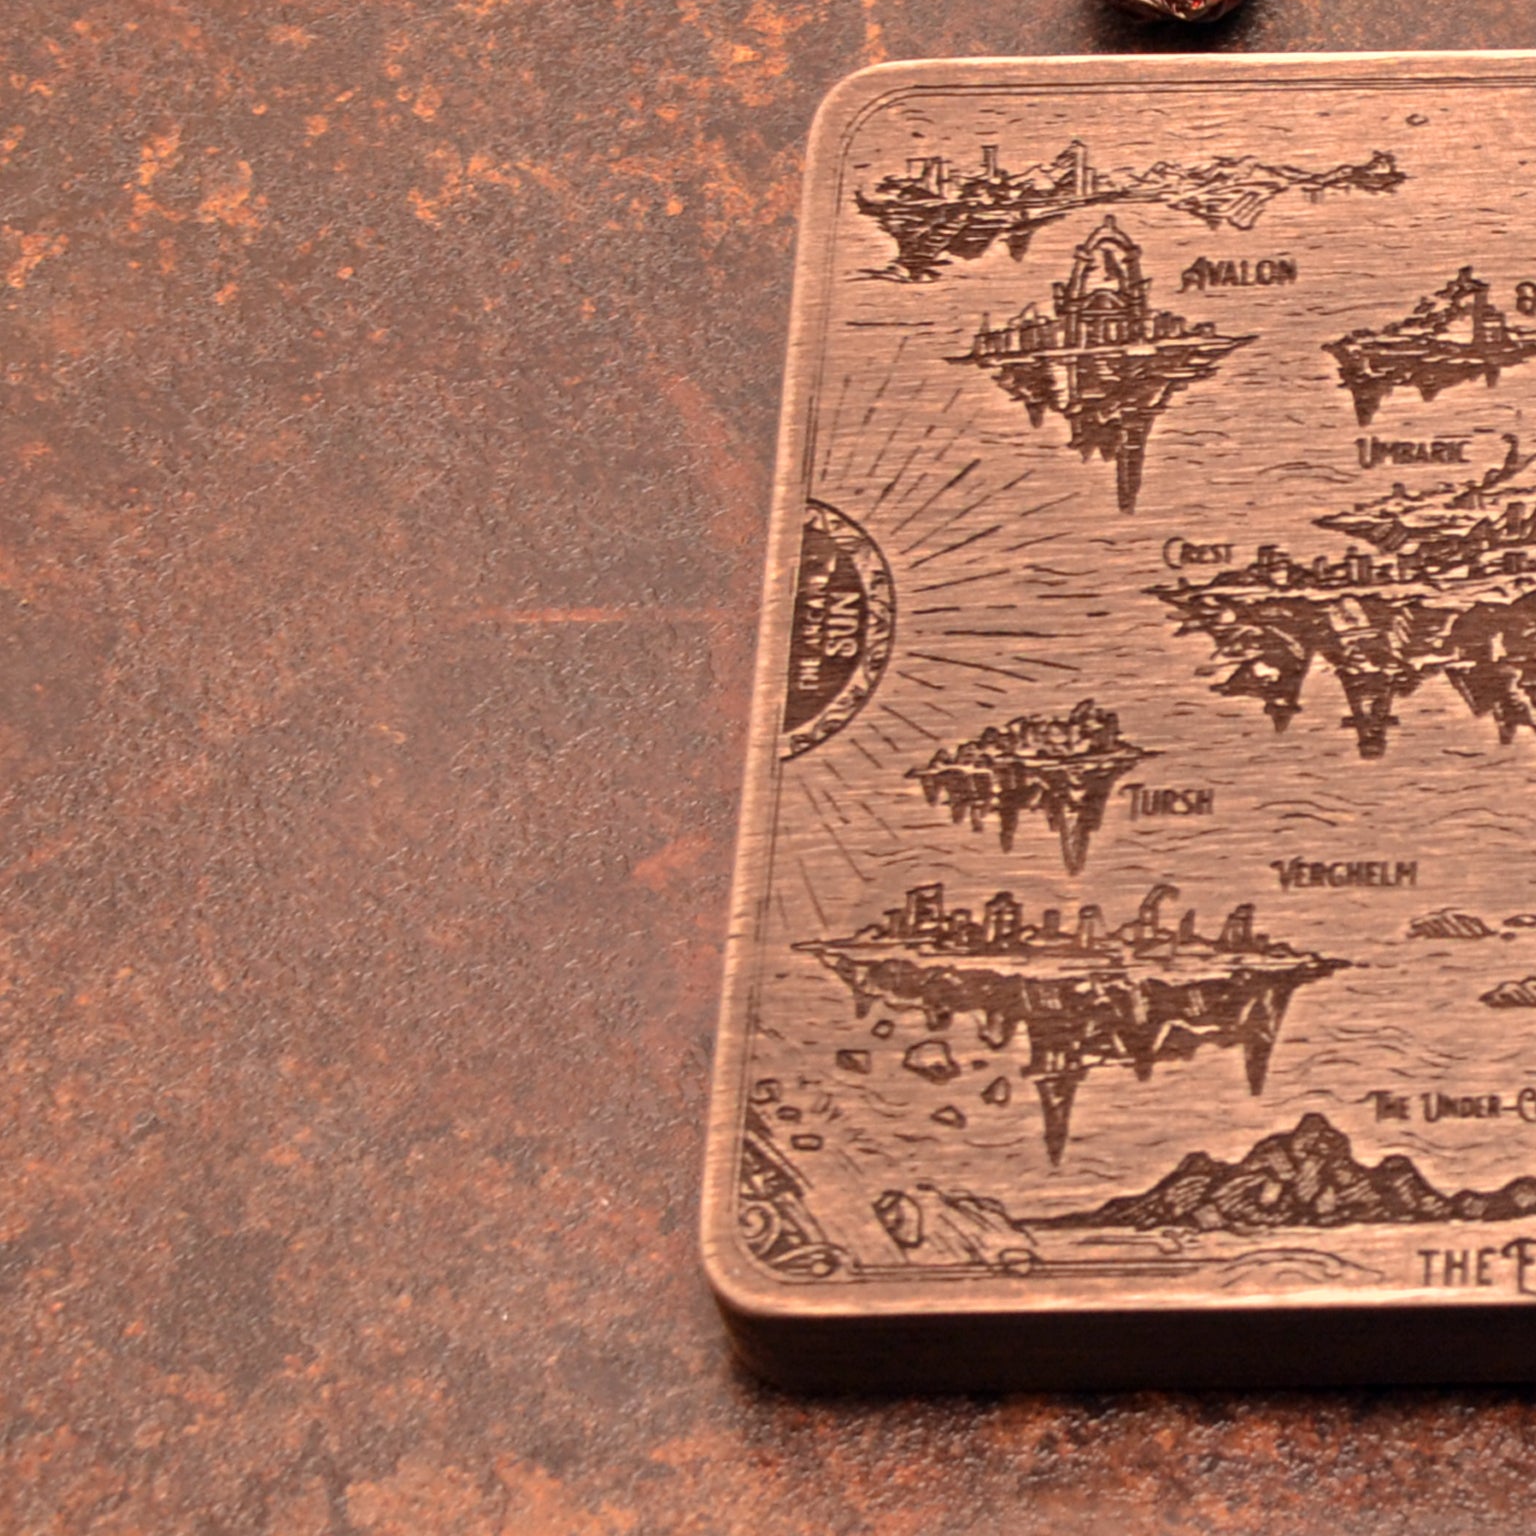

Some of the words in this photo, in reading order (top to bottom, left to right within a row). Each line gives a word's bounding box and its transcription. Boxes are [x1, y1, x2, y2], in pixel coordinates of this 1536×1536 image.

[1177, 255, 1298, 293] AVALON
[825, 591, 862, 658] SUN
[1416, 1248, 1497, 1288] THE
